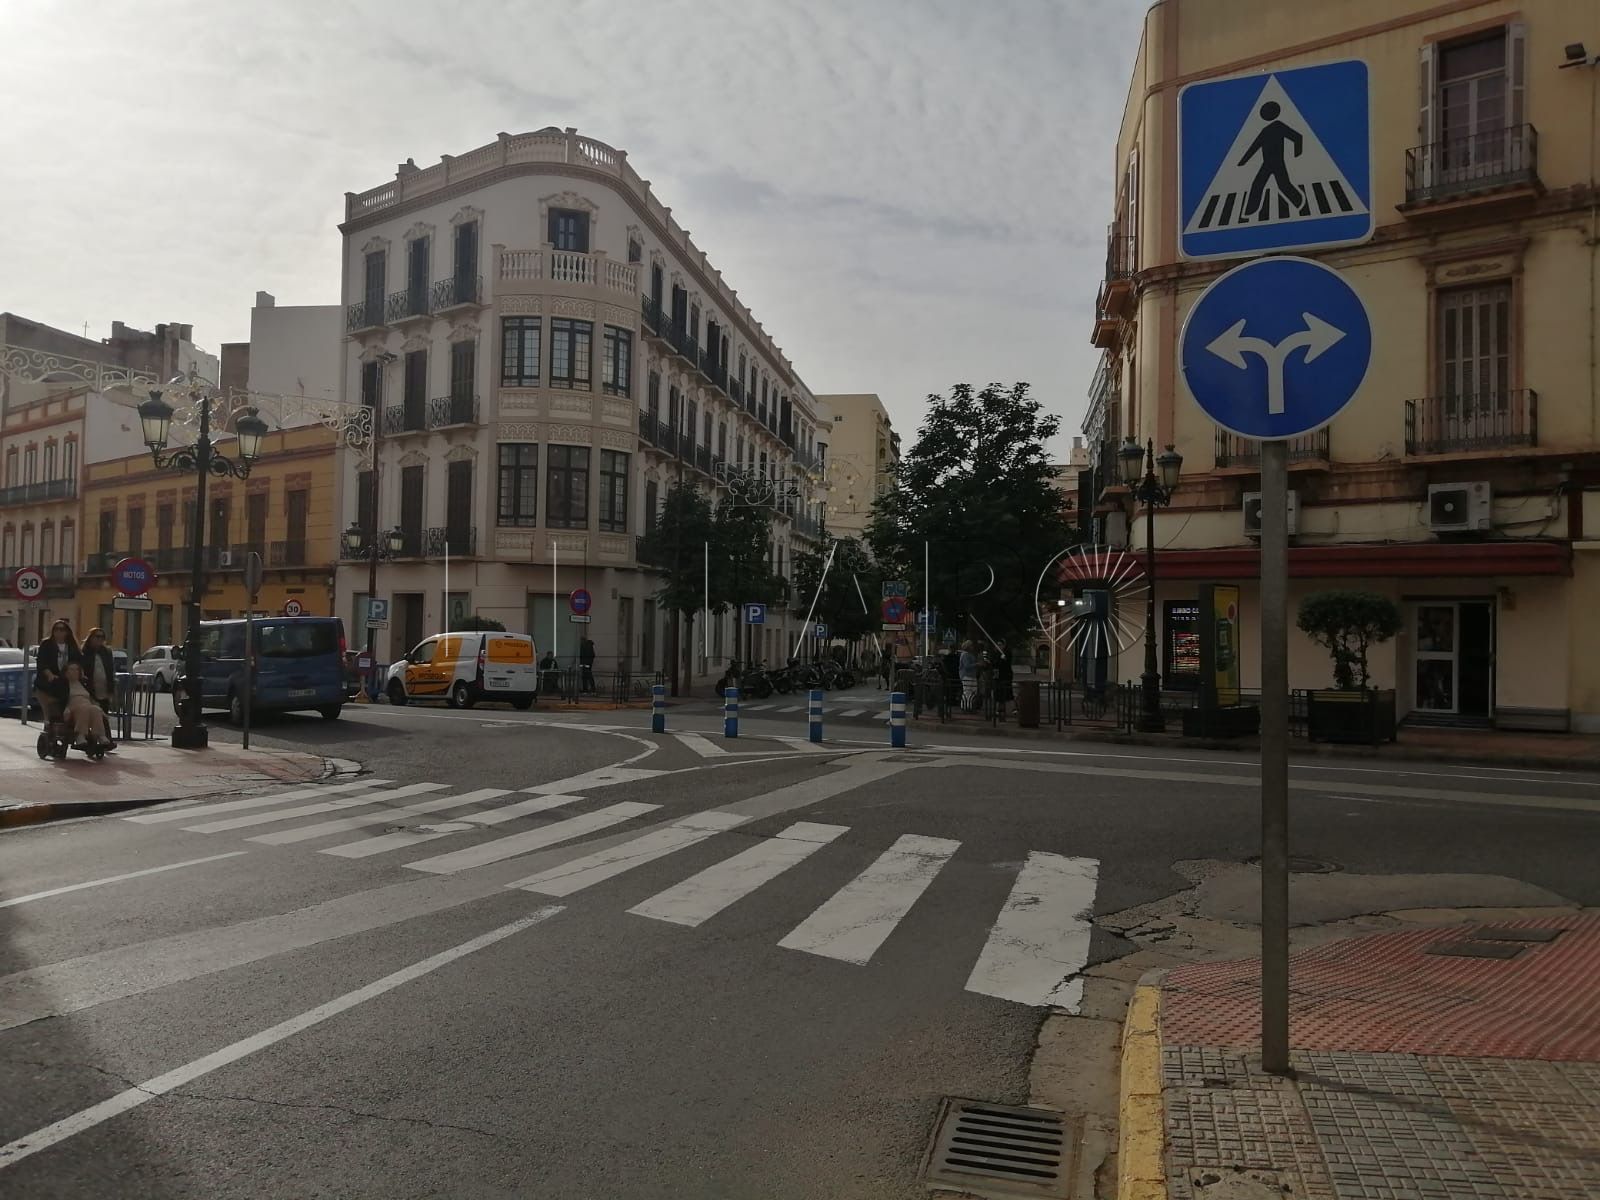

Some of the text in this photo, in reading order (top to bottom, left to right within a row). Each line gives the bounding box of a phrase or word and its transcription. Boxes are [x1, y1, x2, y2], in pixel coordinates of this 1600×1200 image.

[122, 570, 145, 580] MOTOS
[20, 577, 39, 590] 30
[288, 605, 299, 613] 30
[371, 601, 384, 617] P
[749, 606, 761, 621] P
[816, 625, 825, 636] P
